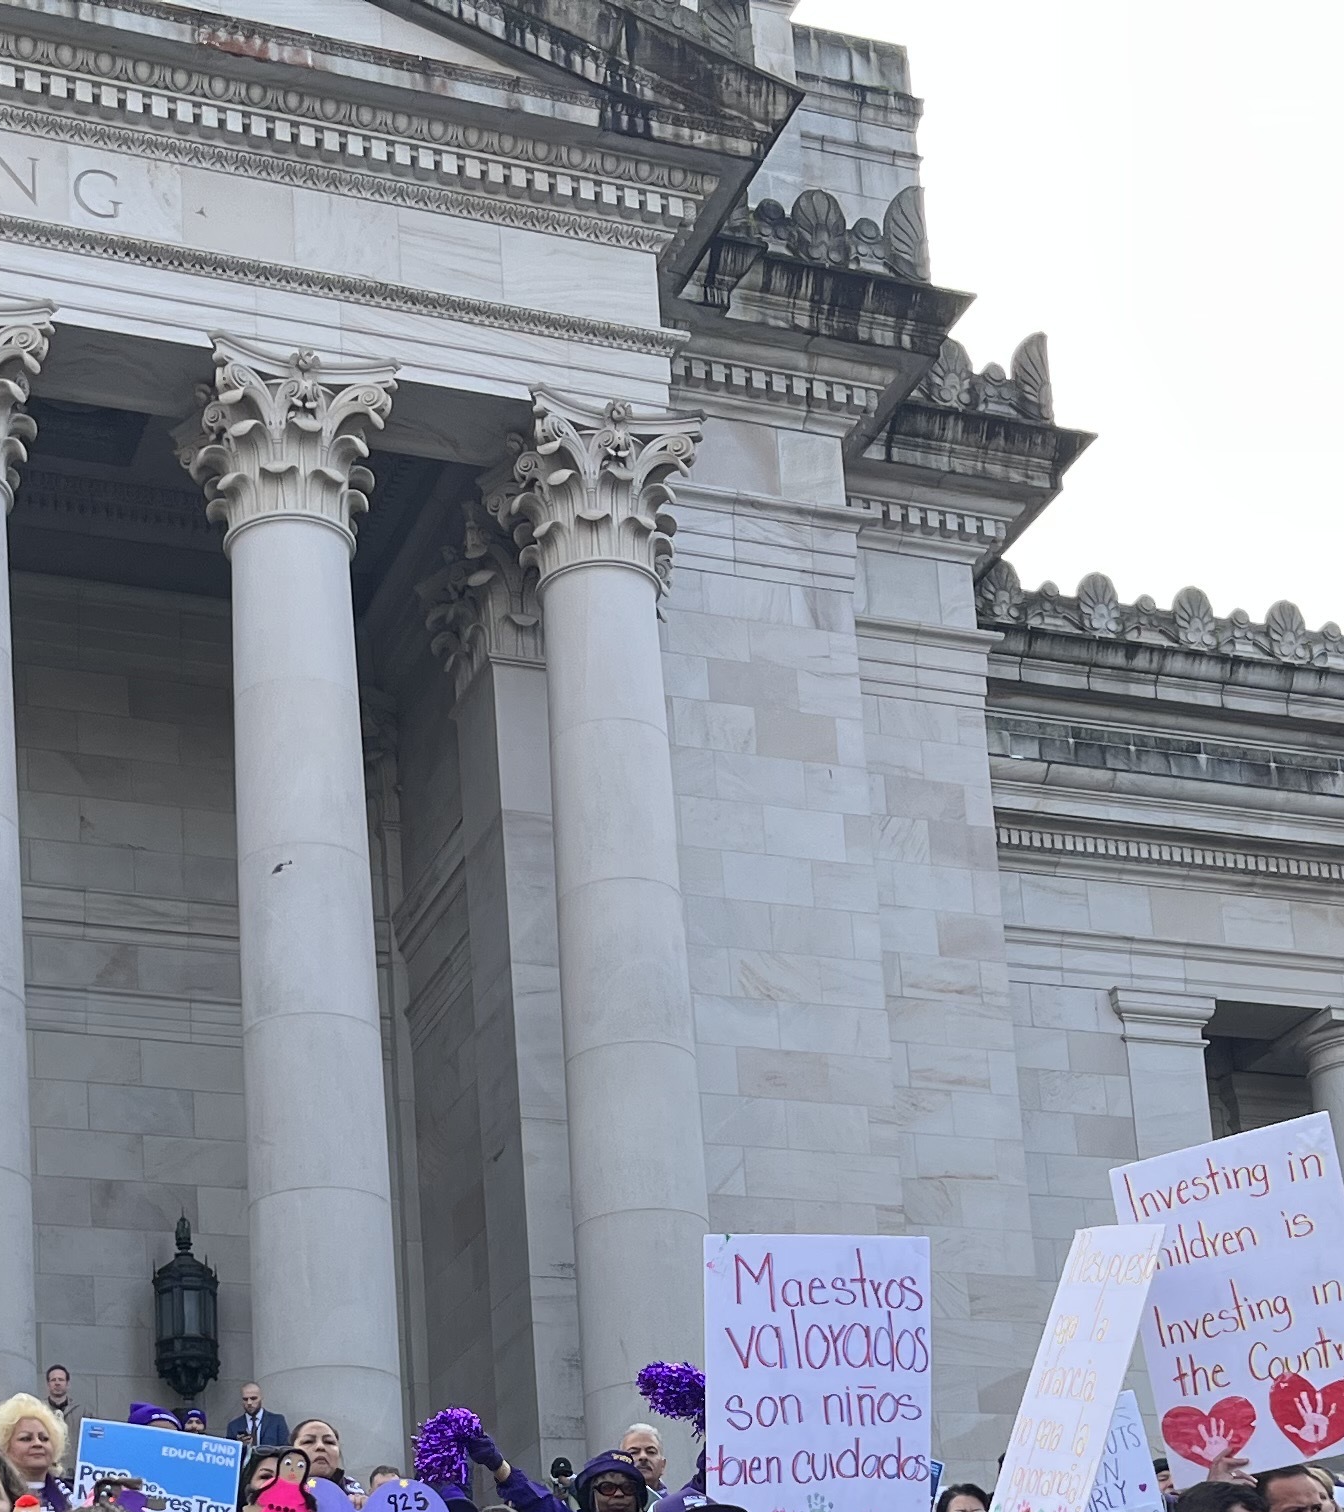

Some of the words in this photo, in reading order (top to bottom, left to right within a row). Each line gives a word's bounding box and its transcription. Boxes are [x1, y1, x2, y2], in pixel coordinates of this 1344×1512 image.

[1123, 1158, 1271, 1223] Investing
[1287, 1151, 1324, 1182] in
[1156, 1220, 1258, 1271] hildren
[1281, 1210, 1315, 1240] is
[734, 1247, 925, 1313] Maestros
[1153, 1278, 1293, 1349] Investing
[1312, 1278, 1343, 1306] in
[724, 1309, 930, 1373] valorados
[1172, 1354, 1232, 1397] the
[724, 1394, 804, 1431] son
[822, 1385, 923, 1427] niños
[161, 1447, 236, 1468] EDUCATION
[202, 1441, 236, 1457] FUND
[718, 1444, 783, 1487] bien
[792, 1436, 931, 1485] cuidados
[1105, 1423, 1141, 1455] UTS
[388, 1491, 429, 1512] 925
